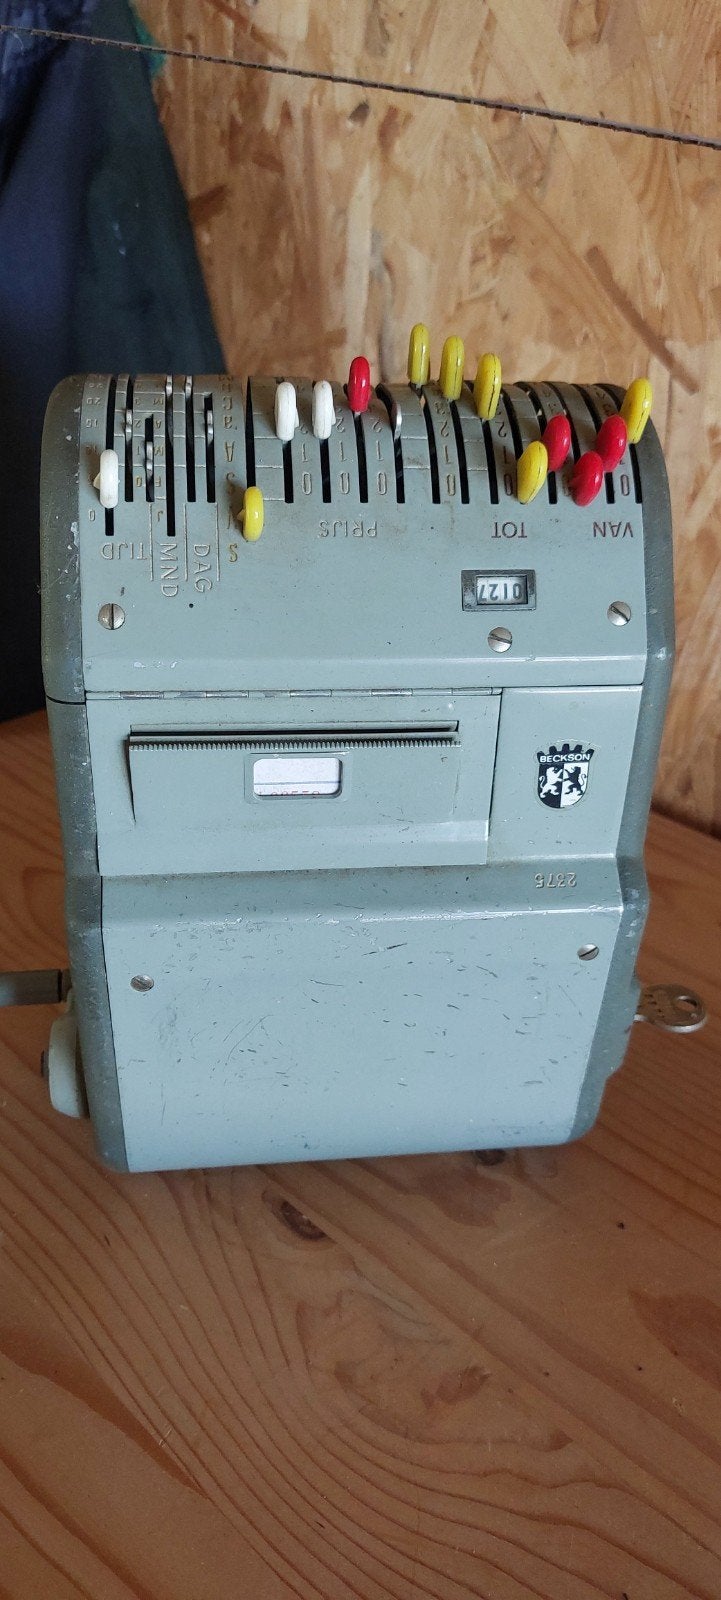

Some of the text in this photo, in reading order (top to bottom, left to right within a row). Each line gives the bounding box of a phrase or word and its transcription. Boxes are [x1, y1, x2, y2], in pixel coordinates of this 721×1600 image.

[86, 397, 101, 405] 20
[85, 418, 98, 428] 15
[371, 417, 383, 433] 2
[436, 421, 450, 437] 2
[495, 421, 507, 438] 2
[224, 440, 236, 462] A
[301, 442, 309, 462] 1
[338, 440, 347, 461] 1
[375, 440, 384, 461] 1
[443, 446, 452, 465] 1
[502, 446, 508, 464] 1
[302, 472, 312, 495] 0
[340, 472, 350, 494] 0
[377, 472, 388, 495] 0
[446, 474, 456, 497] 0
[503, 474, 513, 497] 0
[620, 475, 630, 496] 0
[88, 509, 96, 521] 0
[157, 510, 163, 522] J
[319, 520, 378, 538] PRIJS
[491, 521, 528, 539] TOT
[593, 520, 634, 538] VAN
[101, 542, 148, 560] TIJD
[228, 542, 238, 563] S
[160, 542, 179, 598] MND
[193, 543, 213, 593] DAG
[478, 582, 524, 600] 0127
[539, 753, 591, 764] BECKSON
[534, 872, 577, 888] 2375
